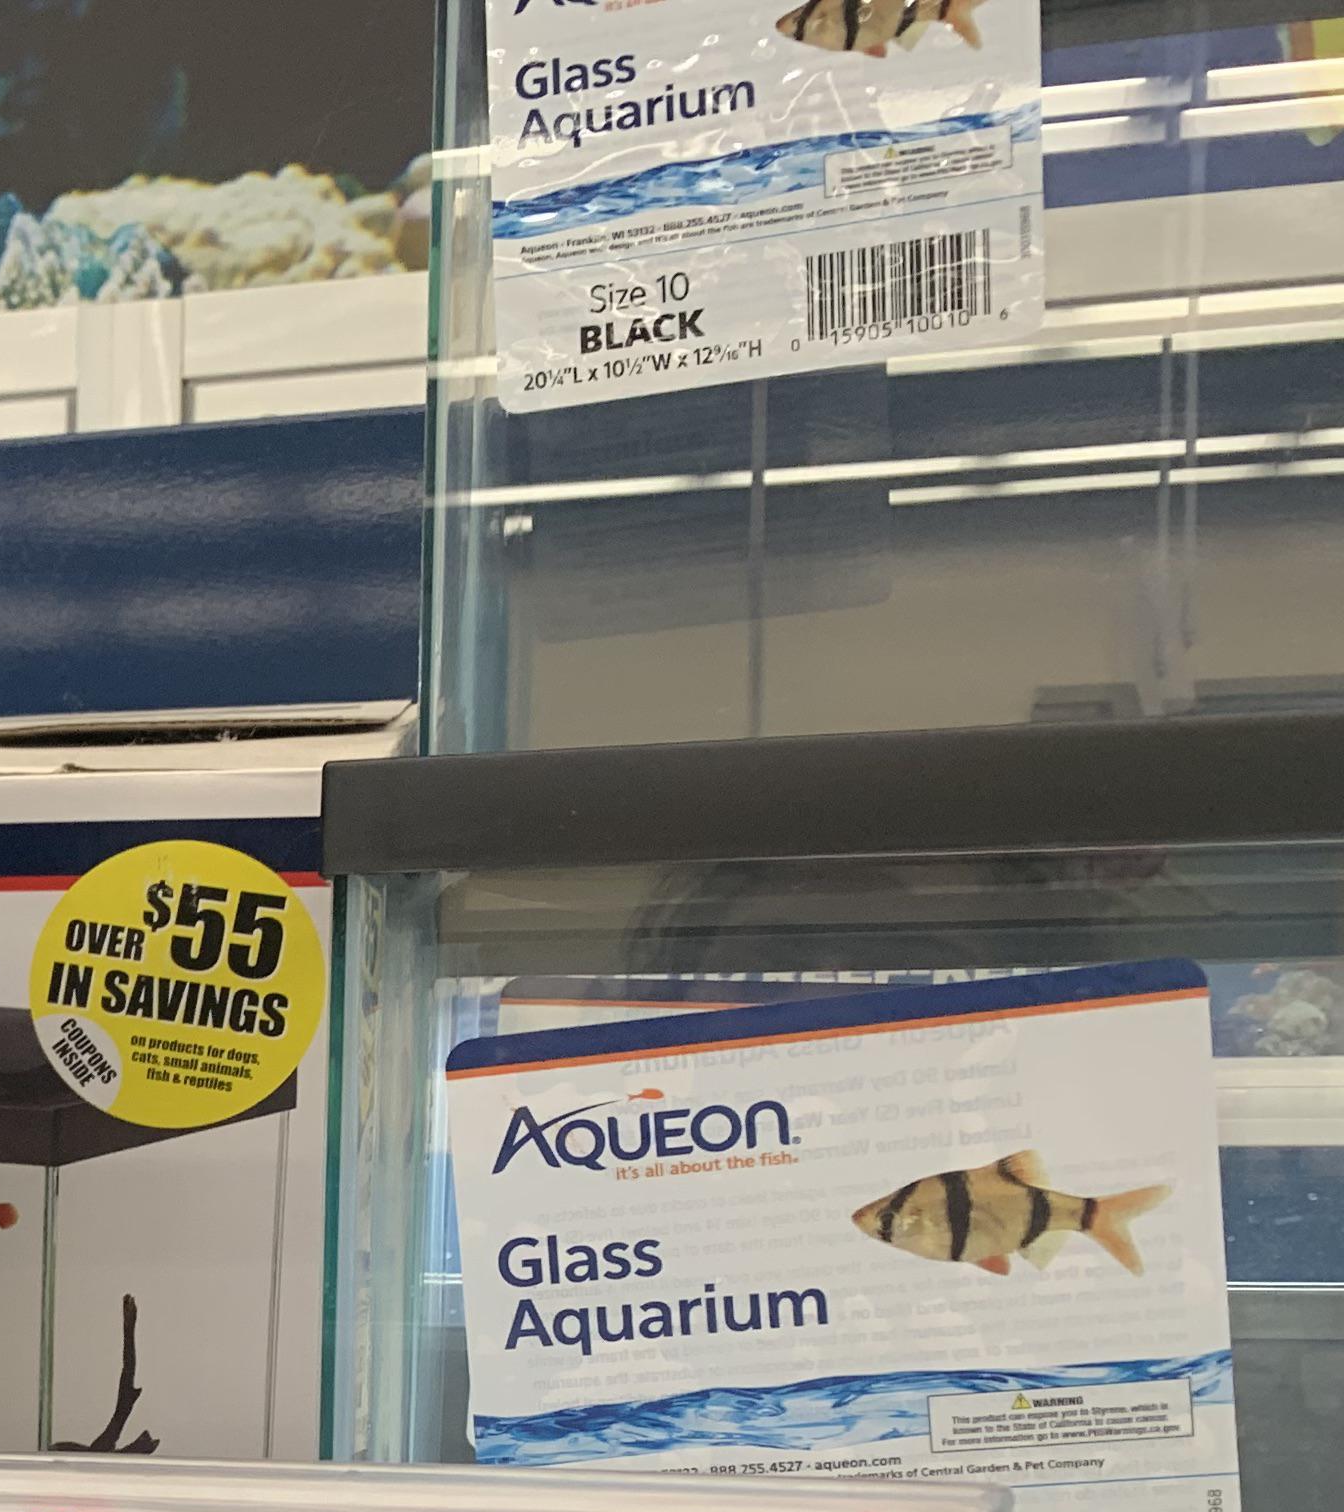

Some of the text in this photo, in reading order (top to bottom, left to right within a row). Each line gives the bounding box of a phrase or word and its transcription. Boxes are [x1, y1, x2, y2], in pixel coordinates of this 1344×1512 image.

[515, 54, 635, 100] Glass
[516, 80, 754, 149] Aquarium
[590, 272, 690, 313] Size 10
[580, 308, 705, 354] BLACK
[791, 308, 1009, 352] 0 15905 10010 6
[588, 368, 598, 382] x
[65, 880, 287, 979] OVER $55
[47, 961, 288, 1037] IN SAVINGS
[52, 1038, 96, 1088] INSIDE
[60, 1017, 117, 1085] COUPONS
[131, 1034, 260, 1065] on products for dogs,
[131, 1051, 161, 1066] cats,
[163, 1054, 198, 1071] small
[146, 1068, 233, 1092] fish & reptiles
[616, 1165, 639, 1181] it's
[645, 1162, 664, 1178] all
[670, 1159, 712, 1177] about
[727, 1154, 754, 1170] the
[497, 1235, 662, 1287] Glass
[504, 1283, 828, 1356] Aquarium
[1032, 1396, 1084, 1408] WARNING
[814, 1455, 902, 1472] aqueon.com
[906, 1467, 918, 1478] of
[921, 1464, 964, 1478] Central
[966, 1461, 1010, 1475] Garden
[1013, 1461, 1022, 1472] &
[1025, 1460, 1044, 1472] Pet
[1047, 1457, 1105, 1471] Company
